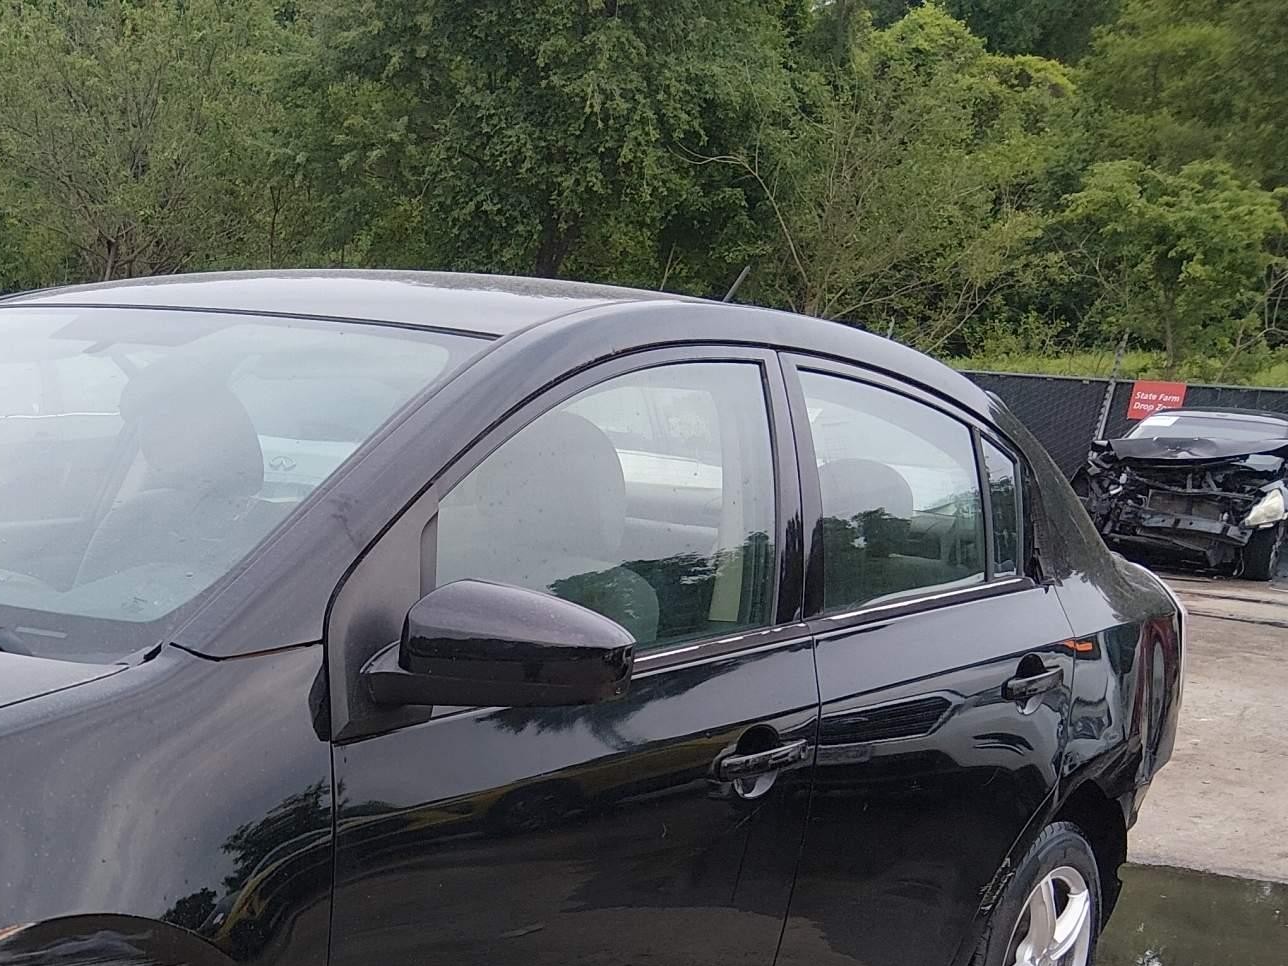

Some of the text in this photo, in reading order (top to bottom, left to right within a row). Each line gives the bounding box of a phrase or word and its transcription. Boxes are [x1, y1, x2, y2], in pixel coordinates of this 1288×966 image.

[1135, 391, 1180, 402] State Farm
[1133, 401, 1155, 412] Drop
